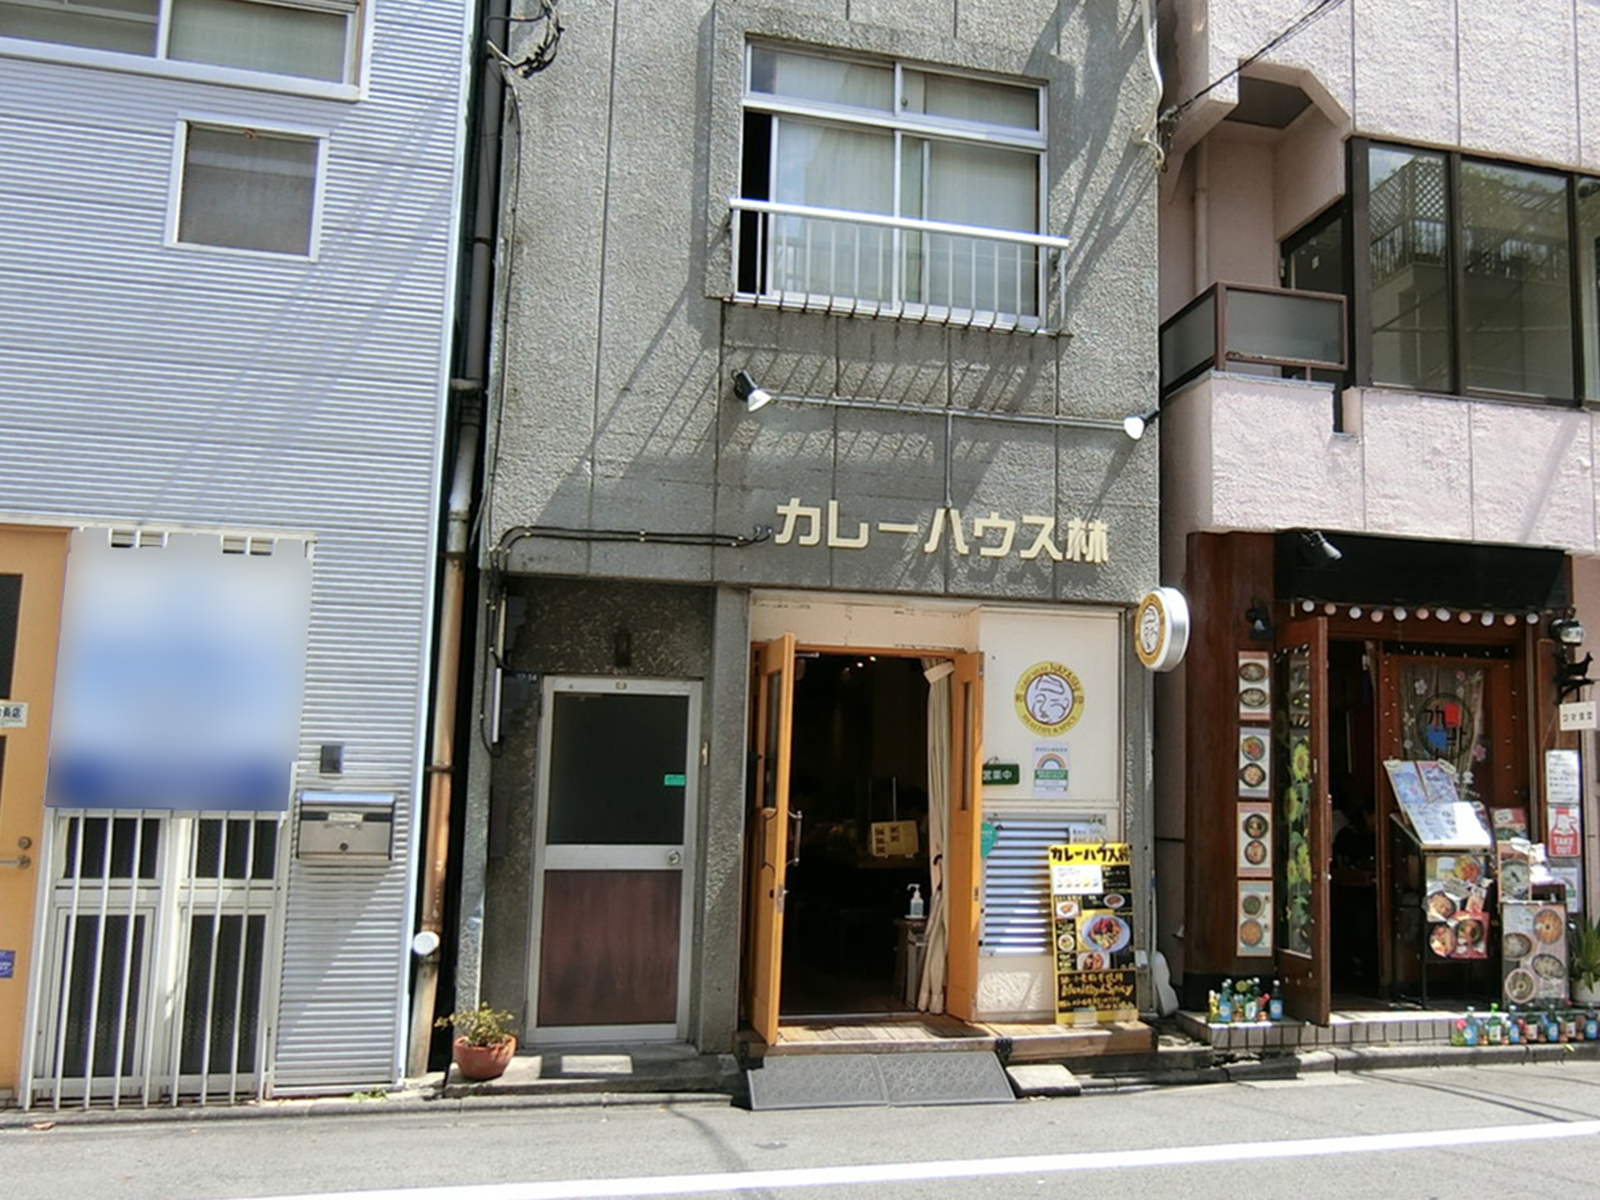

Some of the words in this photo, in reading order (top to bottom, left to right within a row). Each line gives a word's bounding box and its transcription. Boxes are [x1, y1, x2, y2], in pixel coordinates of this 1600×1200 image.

[775, 498, 1109, 563] カレーハウス林
